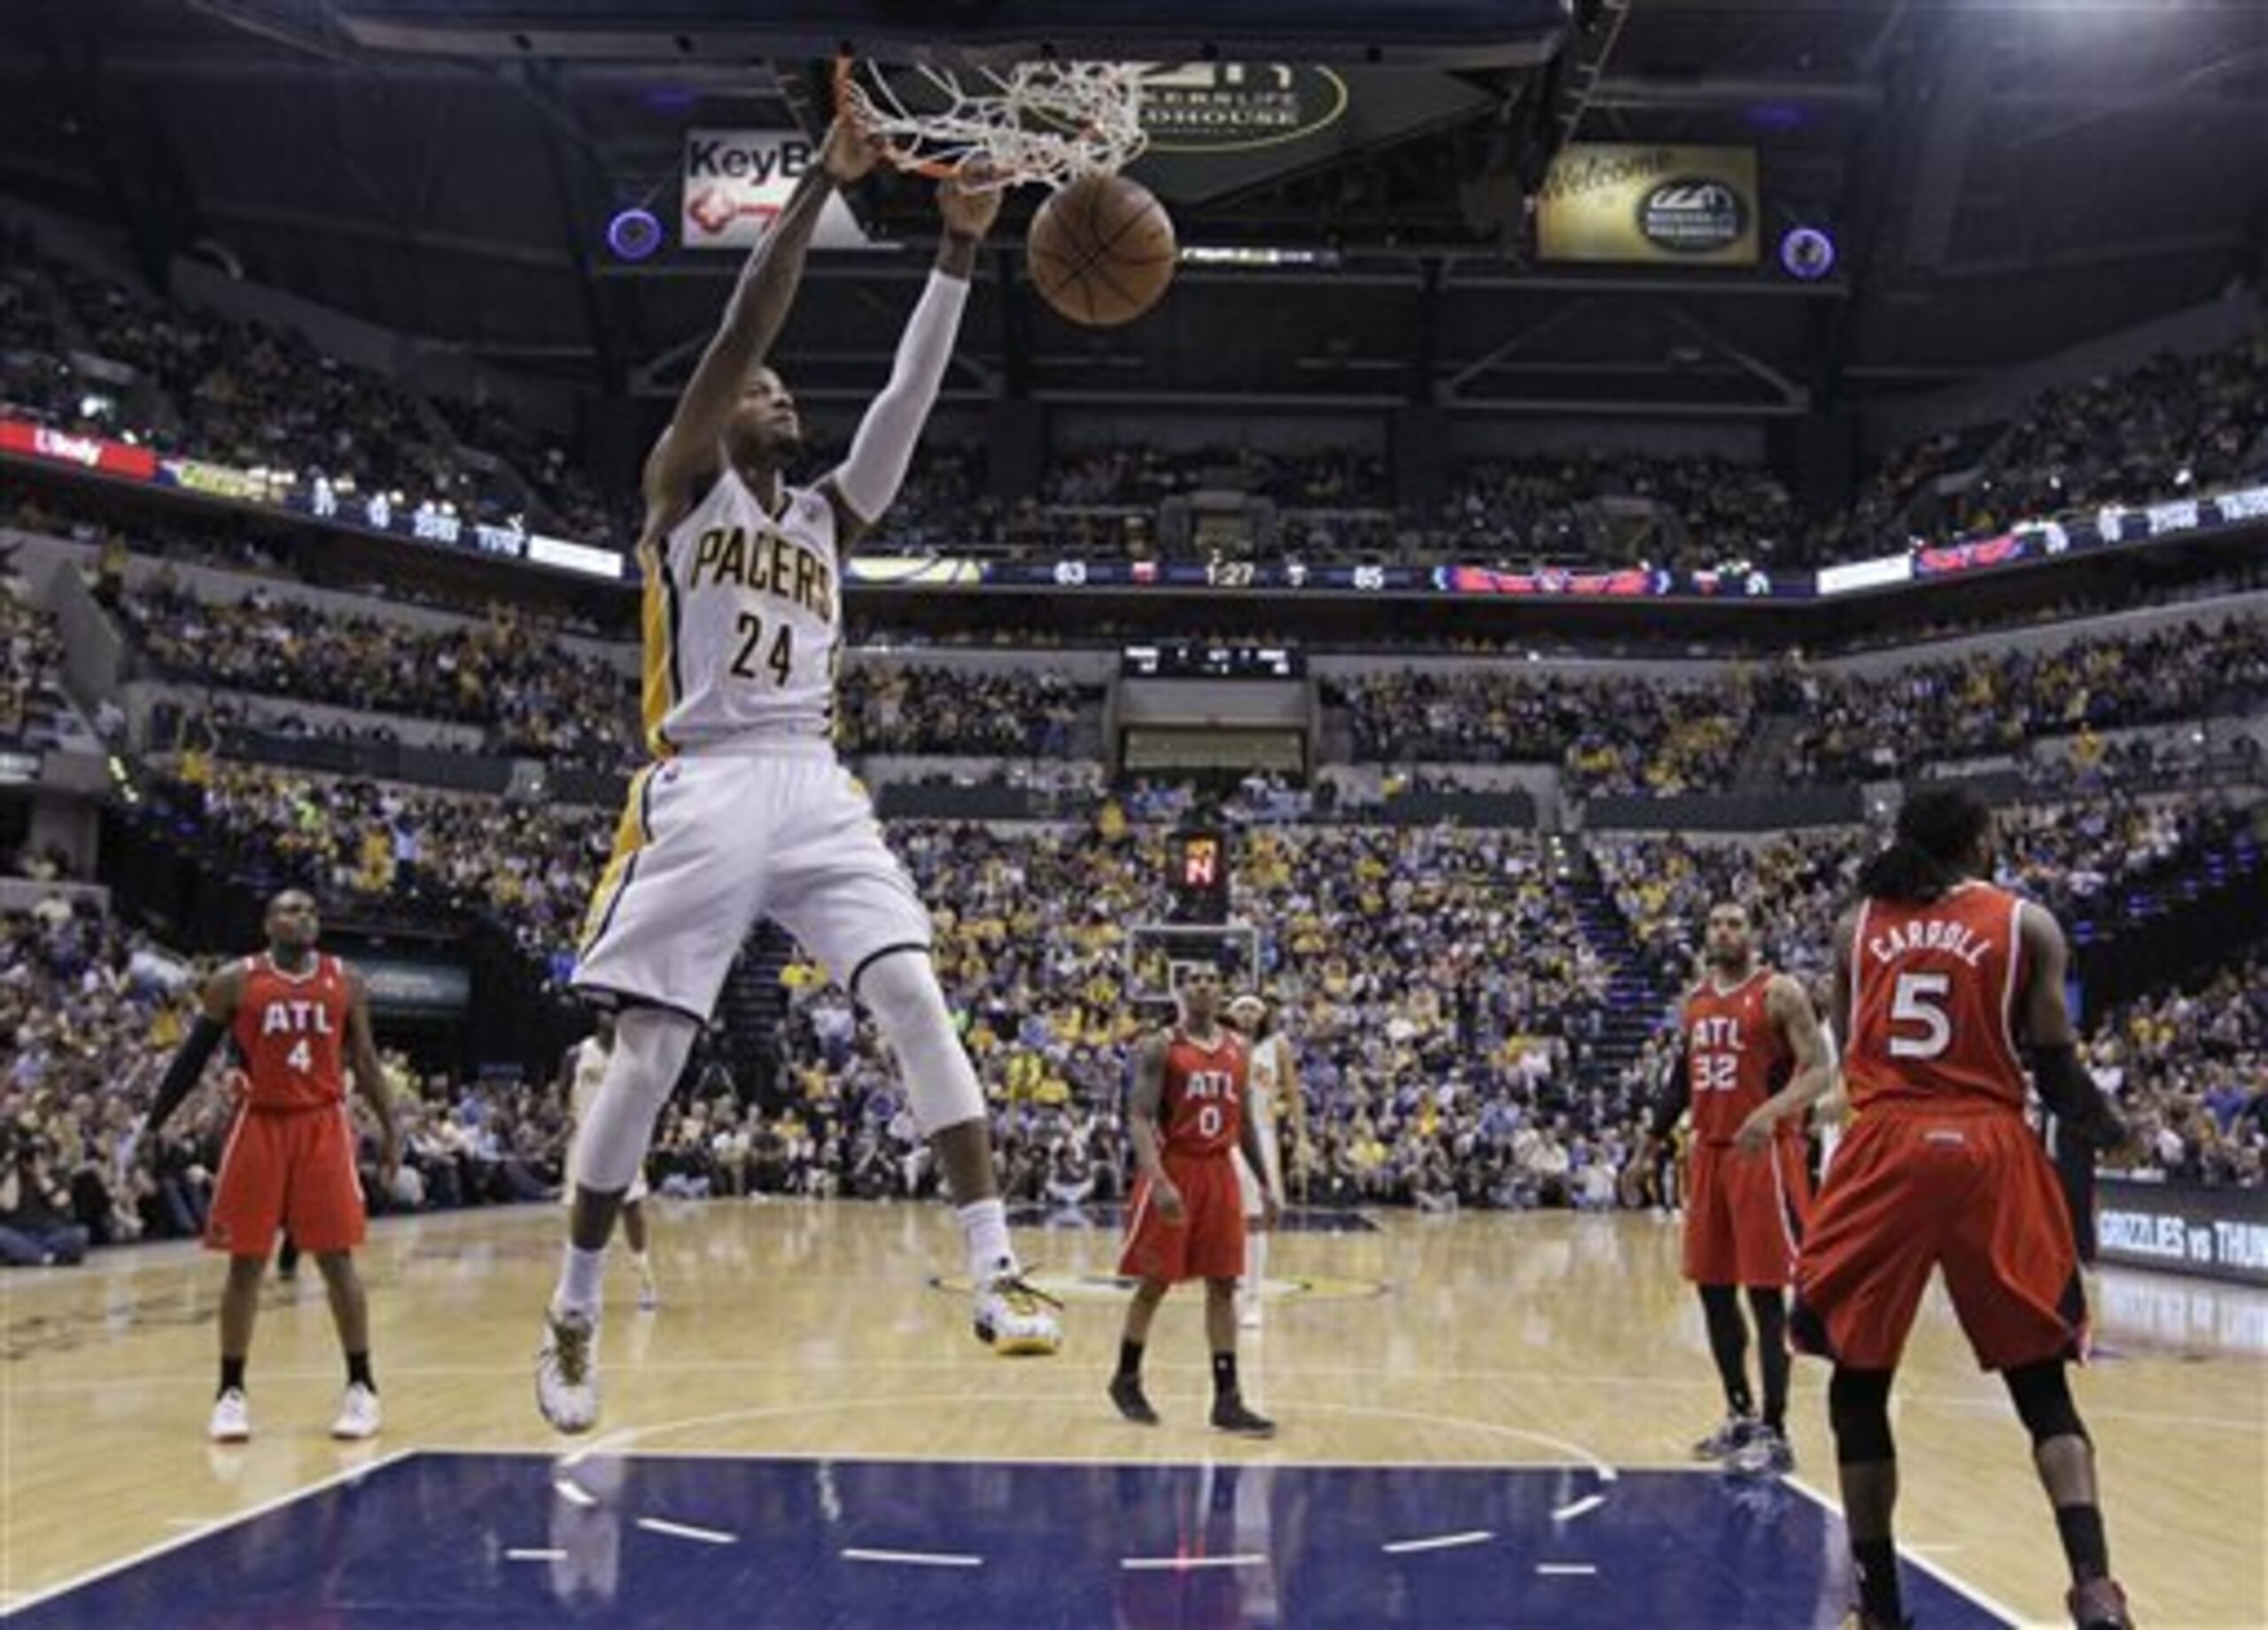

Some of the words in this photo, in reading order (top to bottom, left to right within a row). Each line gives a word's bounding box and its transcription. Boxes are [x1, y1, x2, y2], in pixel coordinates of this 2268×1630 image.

[689, 140, 812, 187] KeyB
[690, 526, 831, 625] PACERS
[730, 608, 791, 687] 24
[1869, 920, 1992, 967] CARROLL
[264, 1001, 333, 1035] ATL
[1889, 973, 1951, 1056] 5
[1691, 1018, 1747, 1051] ATL
[287, 1040, 312, 1073] 4
[1692, 1054, 1738, 1091] 32
[1185, 1070, 1239, 1103] ATL
[1199, 1105, 1221, 1137] 0
[2187, 1228, 2212, 1262] vs
